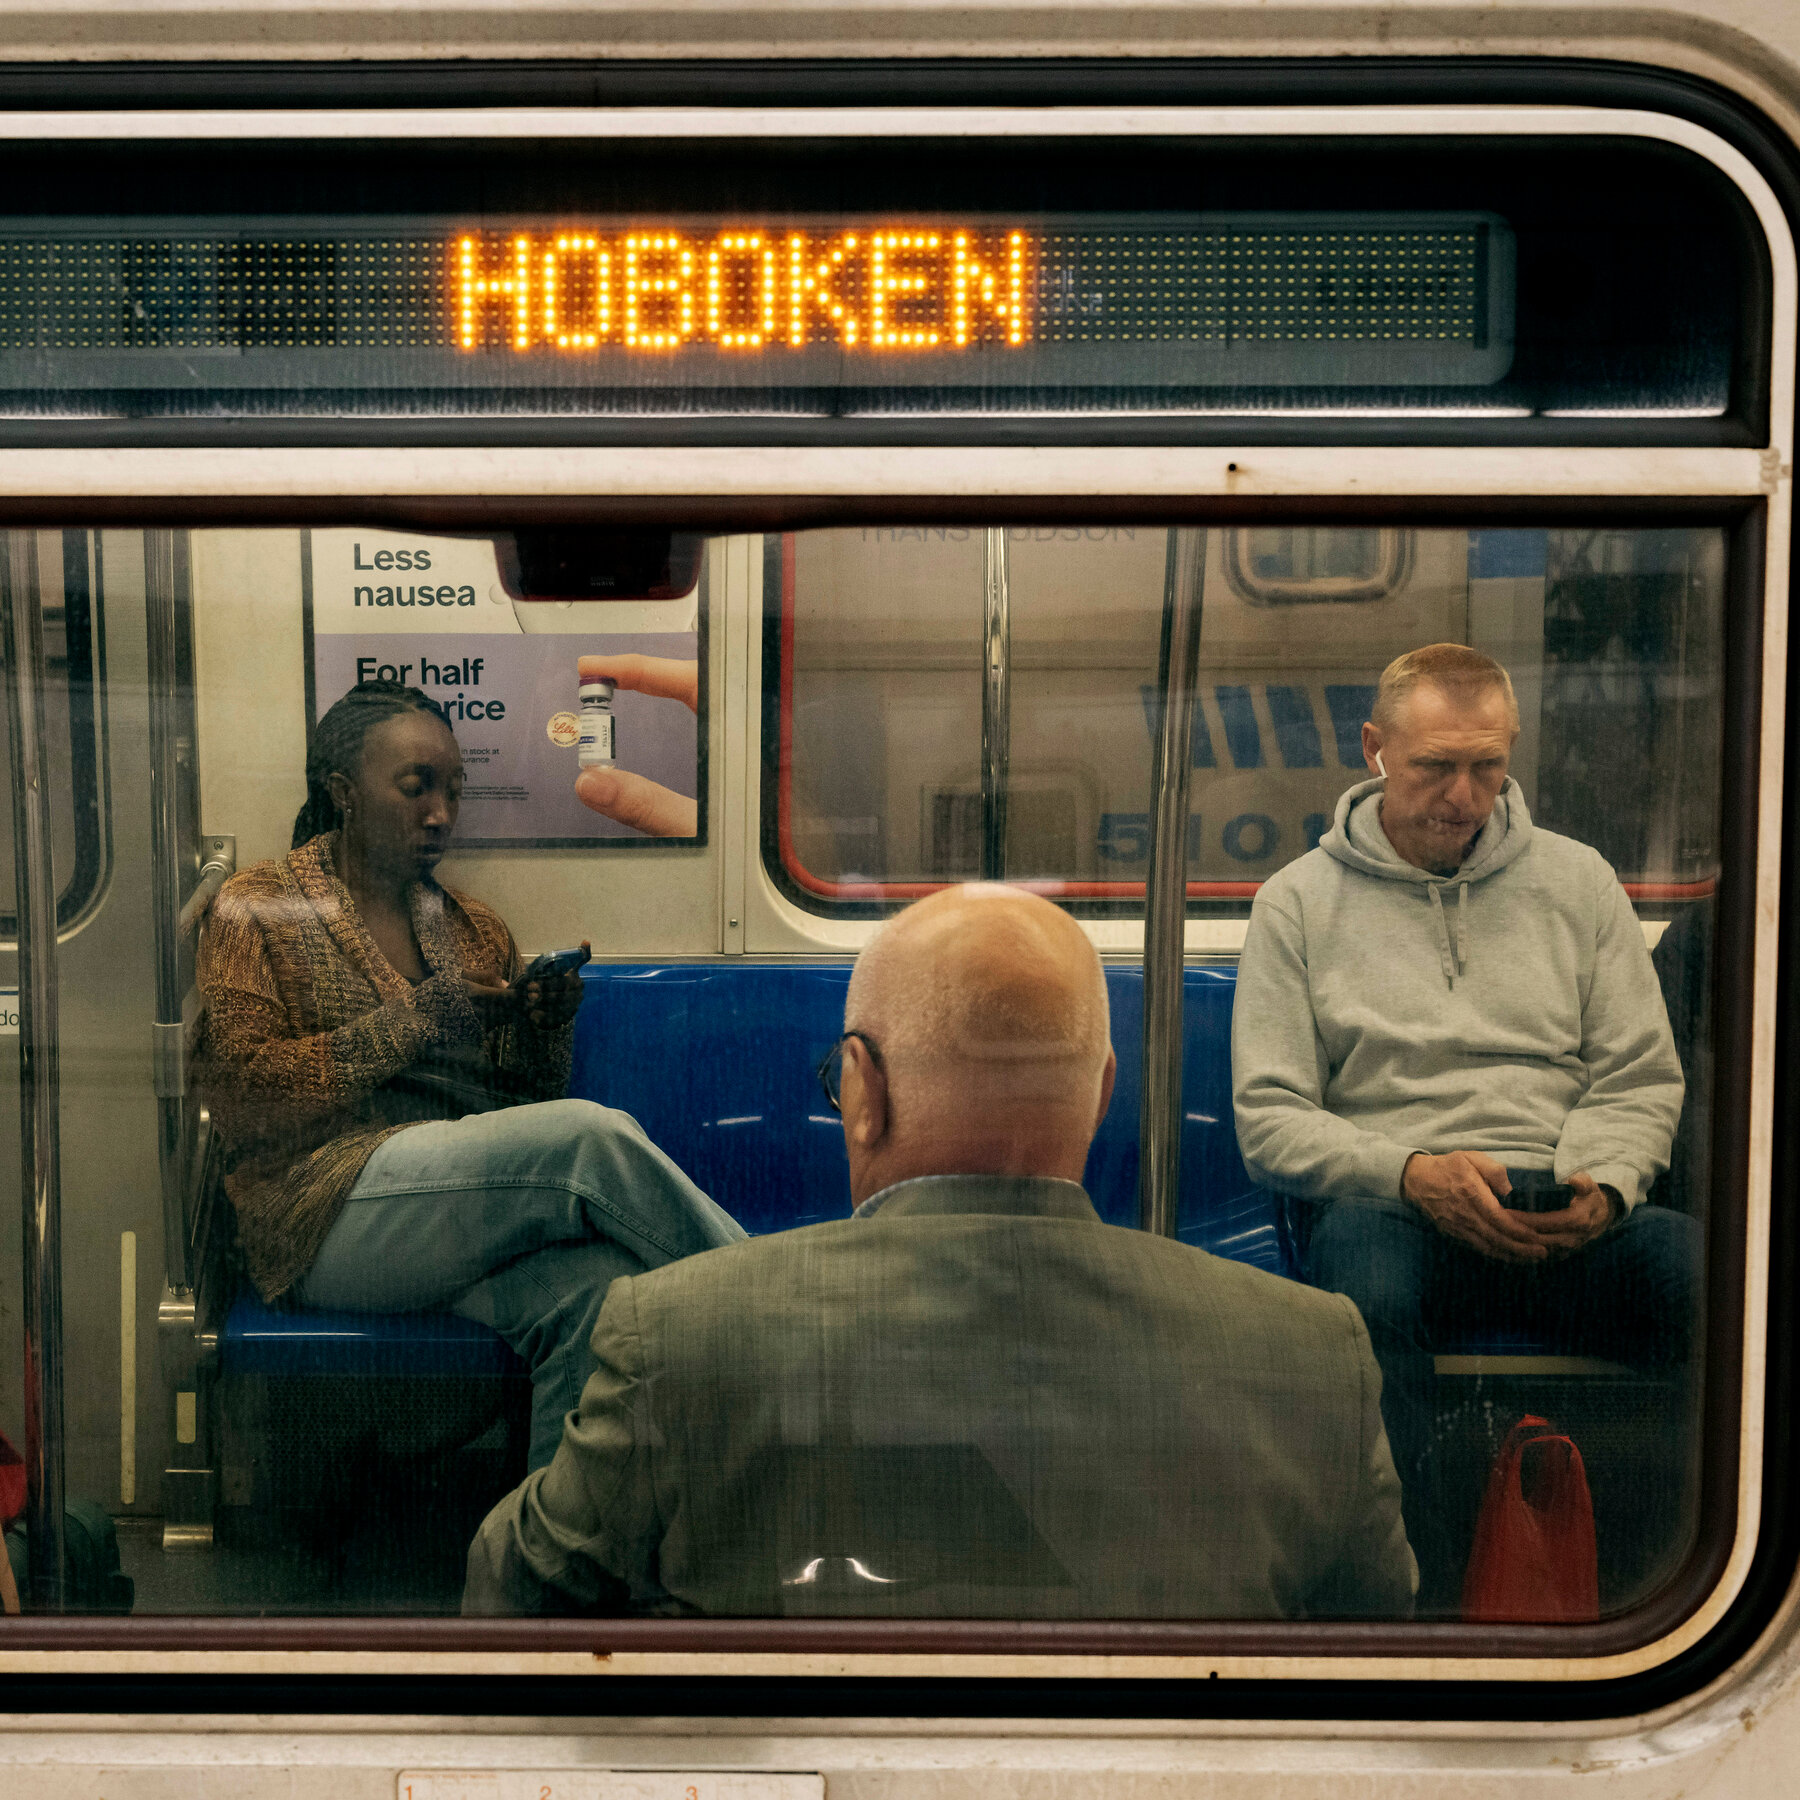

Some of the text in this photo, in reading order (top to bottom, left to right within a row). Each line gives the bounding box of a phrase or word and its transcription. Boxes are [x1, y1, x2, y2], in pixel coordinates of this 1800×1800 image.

[457, 232, 1025, 350] HOBOKEN
[354, 543, 431, 571] Less
[354, 585, 475, 607] nausea
[356, 657, 484, 686] For half
[438, 692, 506, 721] rice
[551, 721, 579, 737] Lilly
[469, 747, 491, 755] stock
